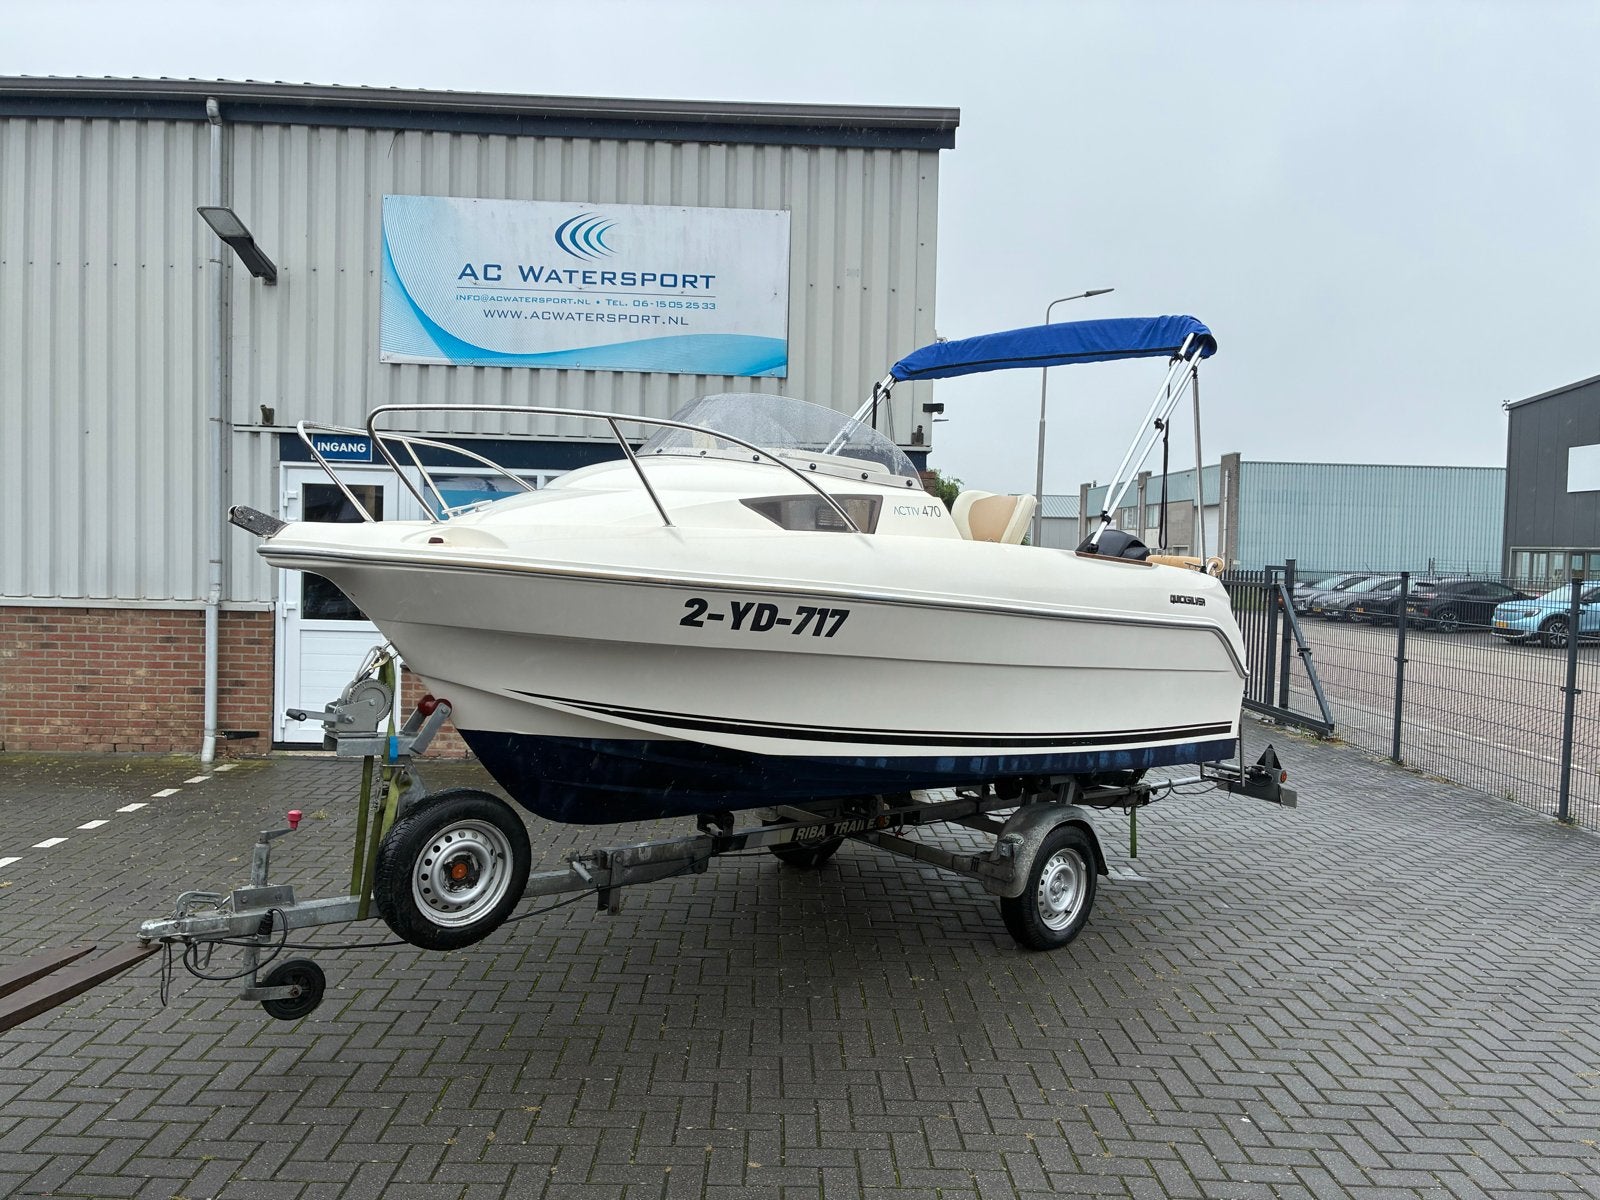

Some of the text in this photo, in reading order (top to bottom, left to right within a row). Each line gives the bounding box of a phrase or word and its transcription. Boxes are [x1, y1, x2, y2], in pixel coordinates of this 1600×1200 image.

[457, 263, 502, 281] AC
[455, 294, 591, 306] INFO@ACWATERSPORT.NL
[483, 309, 689, 326] WWW.ACWATERSPORT.NL
[317, 442, 367, 453] INGANG
[893, 505, 942, 518] ACTIV 470
[679, 597, 851, 638] 2-YD-717
[795, 815, 891, 841] RIBA TRAILES
